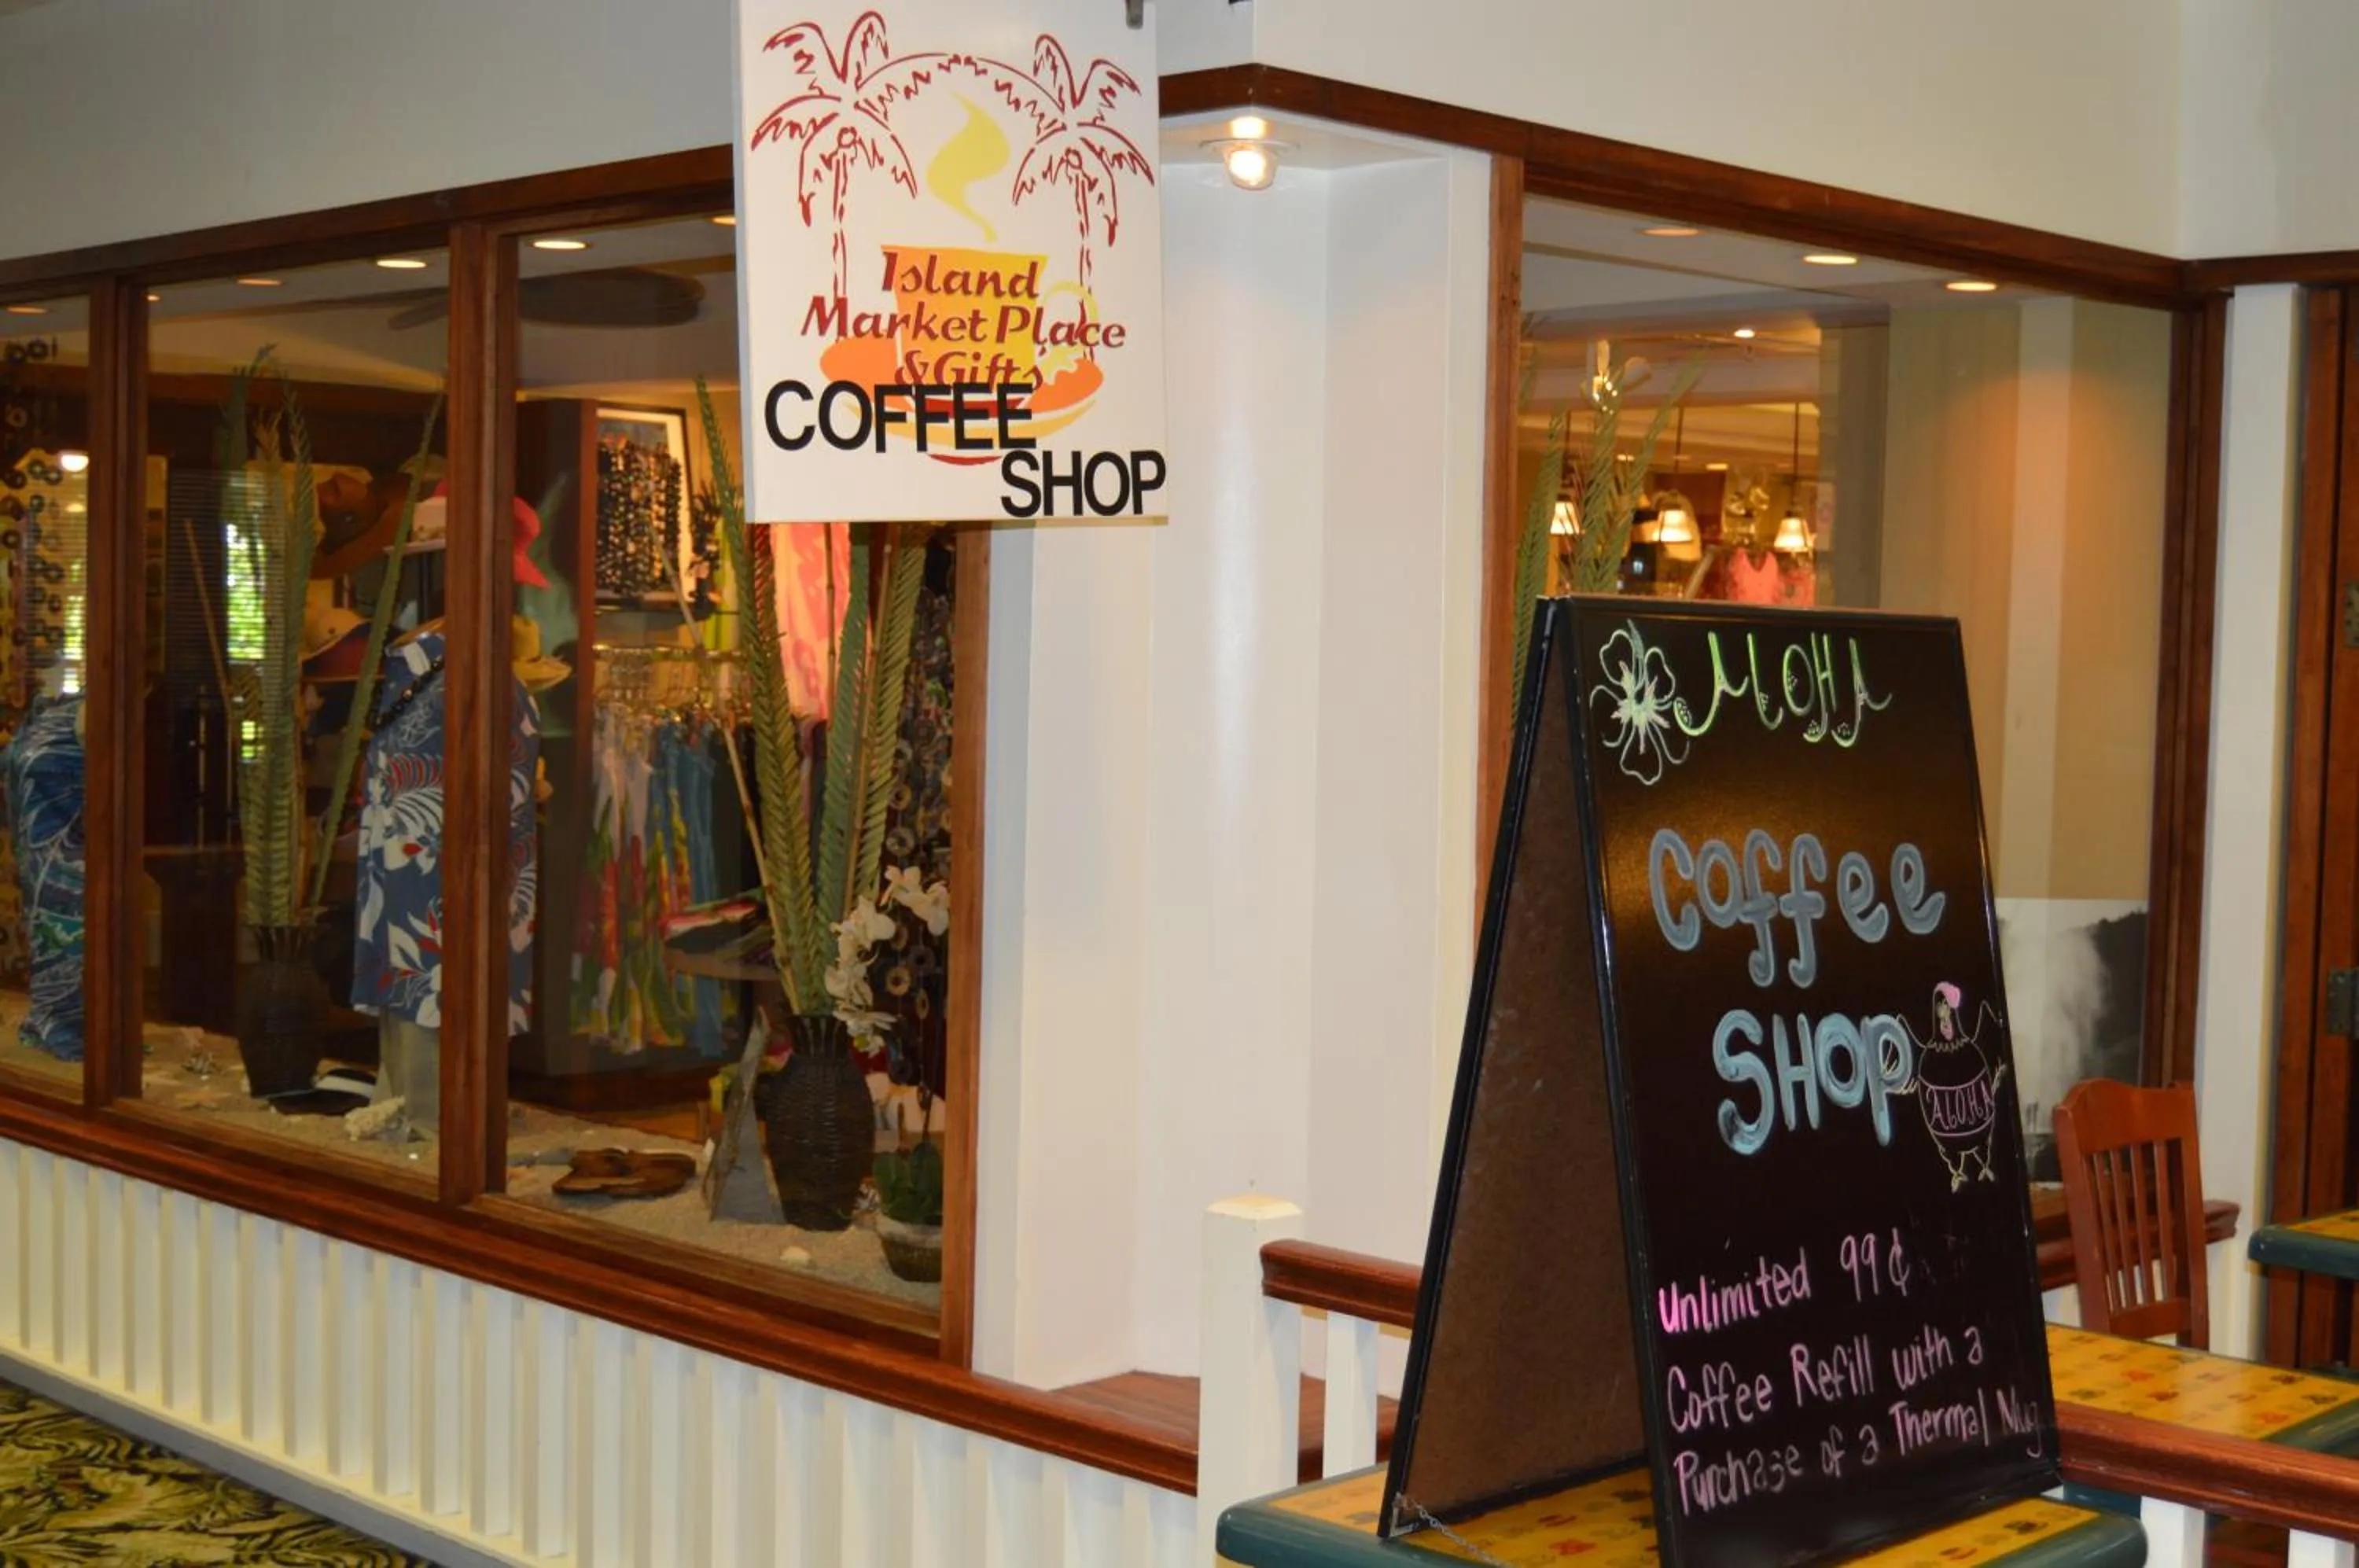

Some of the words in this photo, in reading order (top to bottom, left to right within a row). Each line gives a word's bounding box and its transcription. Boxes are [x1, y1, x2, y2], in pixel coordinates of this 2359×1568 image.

[881, 251, 1040, 298] Island
[764, 380, 1037, 454] COFFEE
[1000, 449, 1167, 518] SHOP
[1649, 828, 1946, 988] Coffee
[1713, 1009, 1912, 1155] SHOP
[1926, 1079, 1996, 1131] ALOHA
[1658, 1246, 1812, 1334] Unlimited
[1666, 1360, 1773, 1434] Coffee
[1789, 1334, 1875, 1407] Refill
[1892, 1323, 1953, 1391] with
[1963, 1326, 1984, 1365] a
[1673, 1444, 1804, 1516] Purchase
[1820, 1423, 1845, 1478] of
[1858, 1424, 1881, 1466] a
[1888, 1386, 1990, 1456] Thermal
